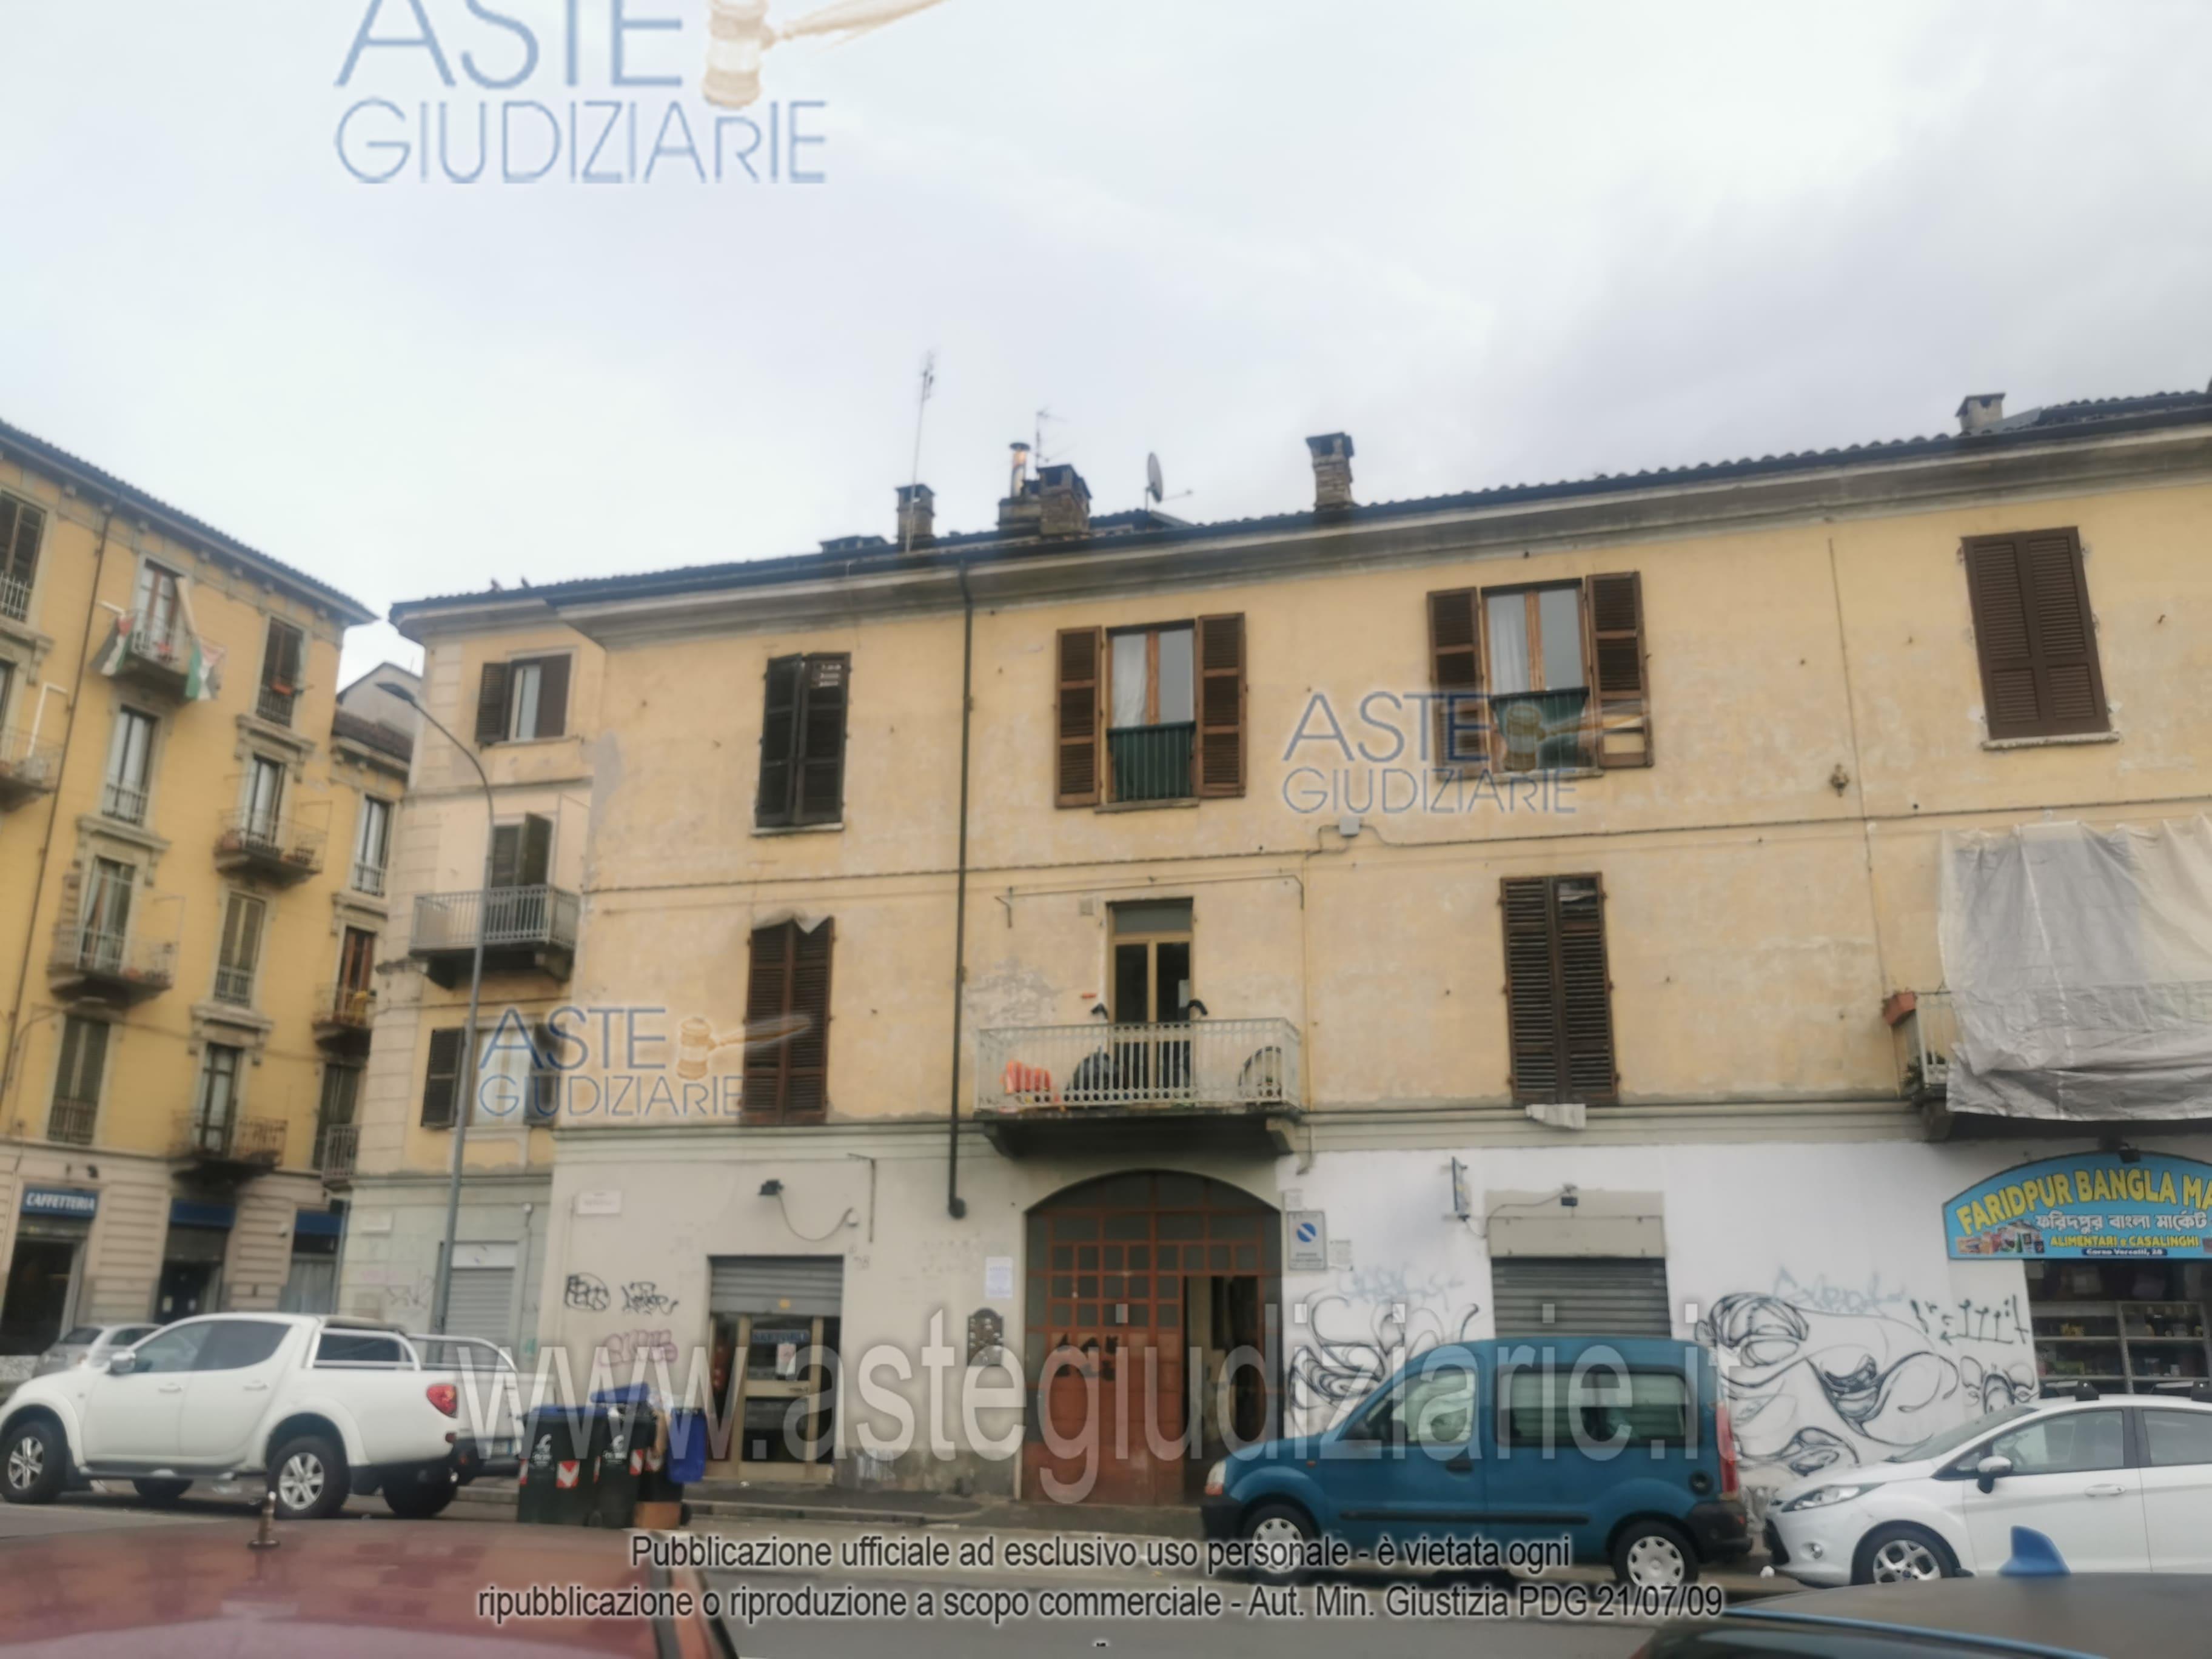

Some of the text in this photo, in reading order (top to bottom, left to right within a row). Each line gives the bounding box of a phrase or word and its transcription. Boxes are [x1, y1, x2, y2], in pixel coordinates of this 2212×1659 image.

[26, 1192, 95, 1211] CAFFETTERIA
[1956, 1173, 2074, 1235] FARIDPUR
[2074, 1168, 2177, 1205] BANGLA
[2035, 1210, 2103, 1234] ফরিদপুর
[2108, 1214, 2151, 1230] বাংলা
[2050, 1236, 2118, 1248] ALIMENTARI
[2128, 1236, 2200, 1248] CASALINGHI
